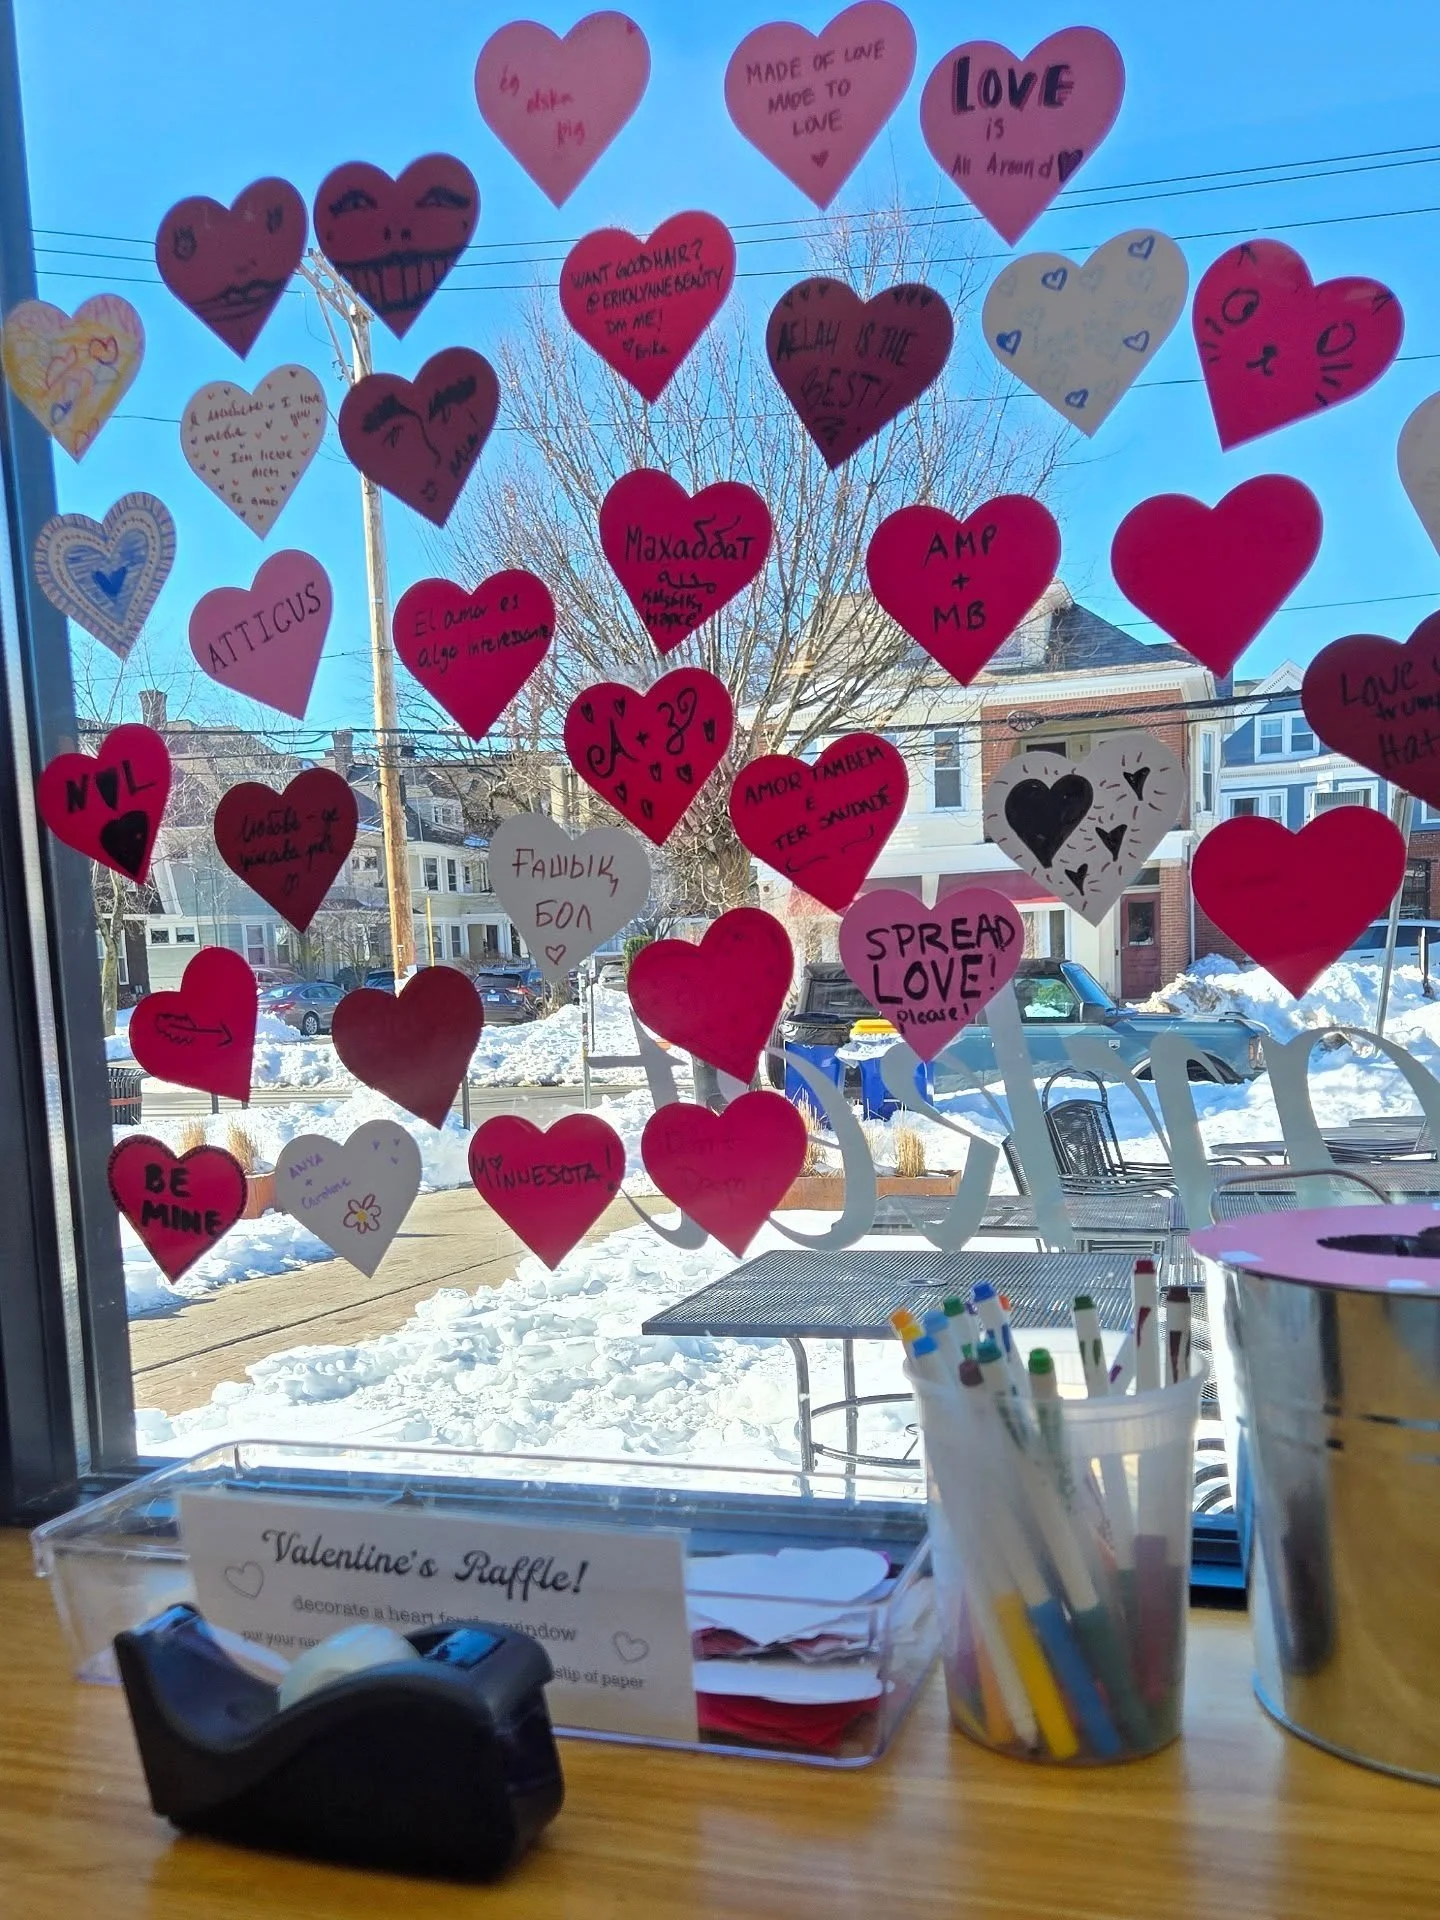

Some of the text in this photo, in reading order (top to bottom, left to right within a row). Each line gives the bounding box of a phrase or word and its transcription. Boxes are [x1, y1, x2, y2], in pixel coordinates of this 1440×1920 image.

[746, 38, 886, 84] MADE OF LOVE
[768, 79, 852, 115] MADE TO
[952, 55, 1075, 115] LOVE
[792, 109, 842, 137] LOVE
[985, 117, 1006, 142] is
[951, 151, 1055, 180] All Around
[570, 239, 704, 290] WANT GOOD HAIR?
[923, 523, 998, 569] AMP
[951, 572, 970, 592] +
[208, 581, 321, 673] ATTICUS
[415, 607, 436, 637] El
[500, 593, 520, 612] es
[933, 600, 986, 633] MB
[418, 642, 458, 674] algo
[1340, 659, 1419, 706] Love
[586, 717, 639, 780] A
[636, 731, 649, 747] +
[64, 760, 156, 814] N L
[744, 771, 802, 807] AMOR
[773, 823, 811, 852] TER
[866, 913, 1016, 961] SPREAD
[872, 953, 997, 1005] LOVE!
[144, 1162, 193, 1198] BE
[141, 1199, 223, 1237] MINE
[261, 1528, 590, 1602] Valentine's Raffle!
[293, 1594, 370, 1619] decorate
[374, 1604, 385, 1620] a
[388, 1604, 434, 1625] heart
[266, 1632, 297, 1648] your
[553, 1663, 646, 1690] slip of paper
